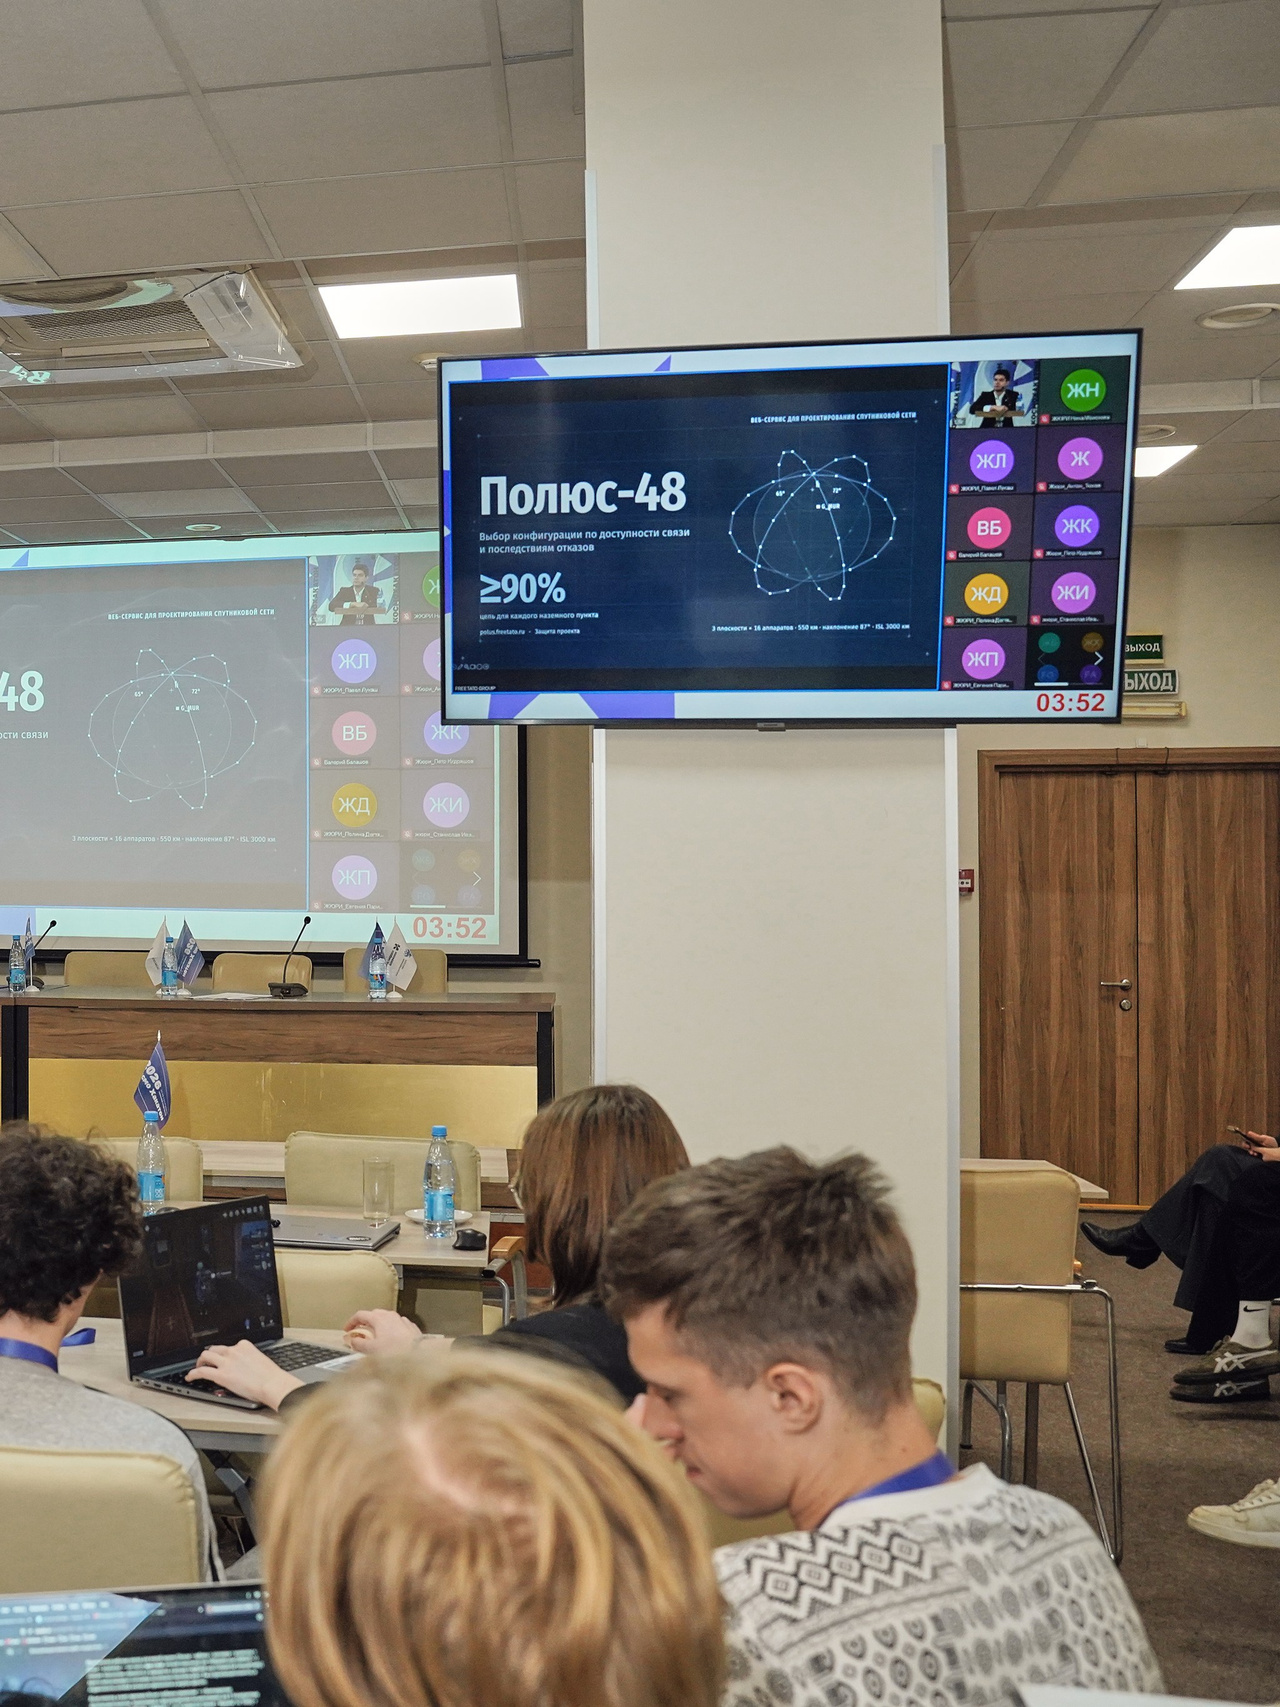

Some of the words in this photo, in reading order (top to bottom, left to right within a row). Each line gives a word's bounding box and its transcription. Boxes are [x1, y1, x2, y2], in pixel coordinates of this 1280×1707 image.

[1067, 383, 1100, 399] ЖН
[750, 415, 786, 424] ВЕБ-СЕРВИС
[787, 415, 800, 423] ДЛЯ
[800, 413, 856, 422] ПРОЕКТИРОВАНИЯ
[856, 411, 900, 420] СПУТНИКОВОЙ
[901, 411, 917, 419] СЕТИ
[976, 453, 1006, 469] ЖЛ
[1070, 450, 1091, 467] Ж
[480, 471, 687, 515] Полюс-48
[977, 520, 1002, 536] ВБ
[1062, 518, 1093, 534] ЖК
[479, 532, 510, 542] Выбор
[512, 530, 583, 542] конфигурации
[585, 530, 598, 540] по
[599, 529, 660, 540] доступности
[662, 528, 690, 538] связи
[479, 546, 486, 554] и
[488, 544, 554, 554] последствиям
[556, 544, 595, 552] отказов
[970, 586, 1002, 604] ЖД
[1056, 585, 1090, 601] ЖИ
[214, 608, 258, 617] СПУТНИКОВОЙ
[259, 608, 275, 616] СЕТИ
[510, 612, 538, 620] каждого
[576, 612, 599, 620] пункта
[480, 628, 525, 636] polus.freetato.ru
[557, 628, 580, 636] проекта
[338, 653, 369, 669] ЖЛ
[968, 652, 999, 667] ЖП
[1124, 672, 1173, 691] ЫХОД
[1036, 692, 1106, 712] 03:52
[21, 731, 48, 739] связи
[342, 725, 368, 741] ВБ
[431, 725, 462, 740] ЖК
[338, 797, 370, 816] ЖД
[429, 797, 463, 813] ЖИ
[338, 869, 370, 885] ЖП
[413, 917, 487, 939] 03:52
[149, 1088, 164, 1121] Хакатон
